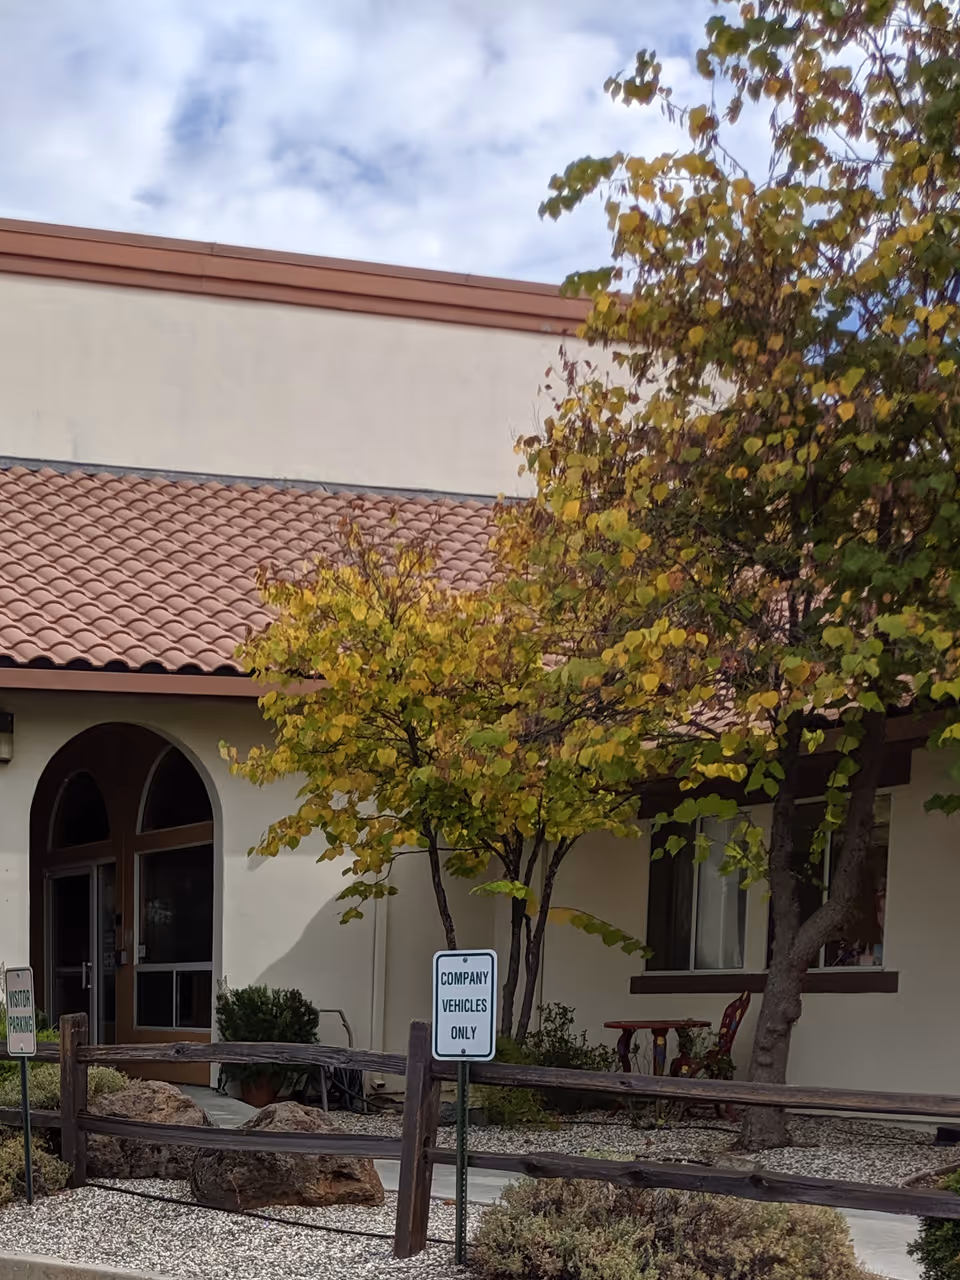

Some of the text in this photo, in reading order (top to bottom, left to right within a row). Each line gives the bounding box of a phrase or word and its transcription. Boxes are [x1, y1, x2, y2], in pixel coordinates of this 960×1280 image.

[441, 971, 489, 986] COMPANY
[8, 989, 31, 1008] VISITOR
[442, 998, 487, 1013] VEHICLES
[9, 1015, 33, 1034] PARKING
[450, 1026, 477, 1040] ONLY
